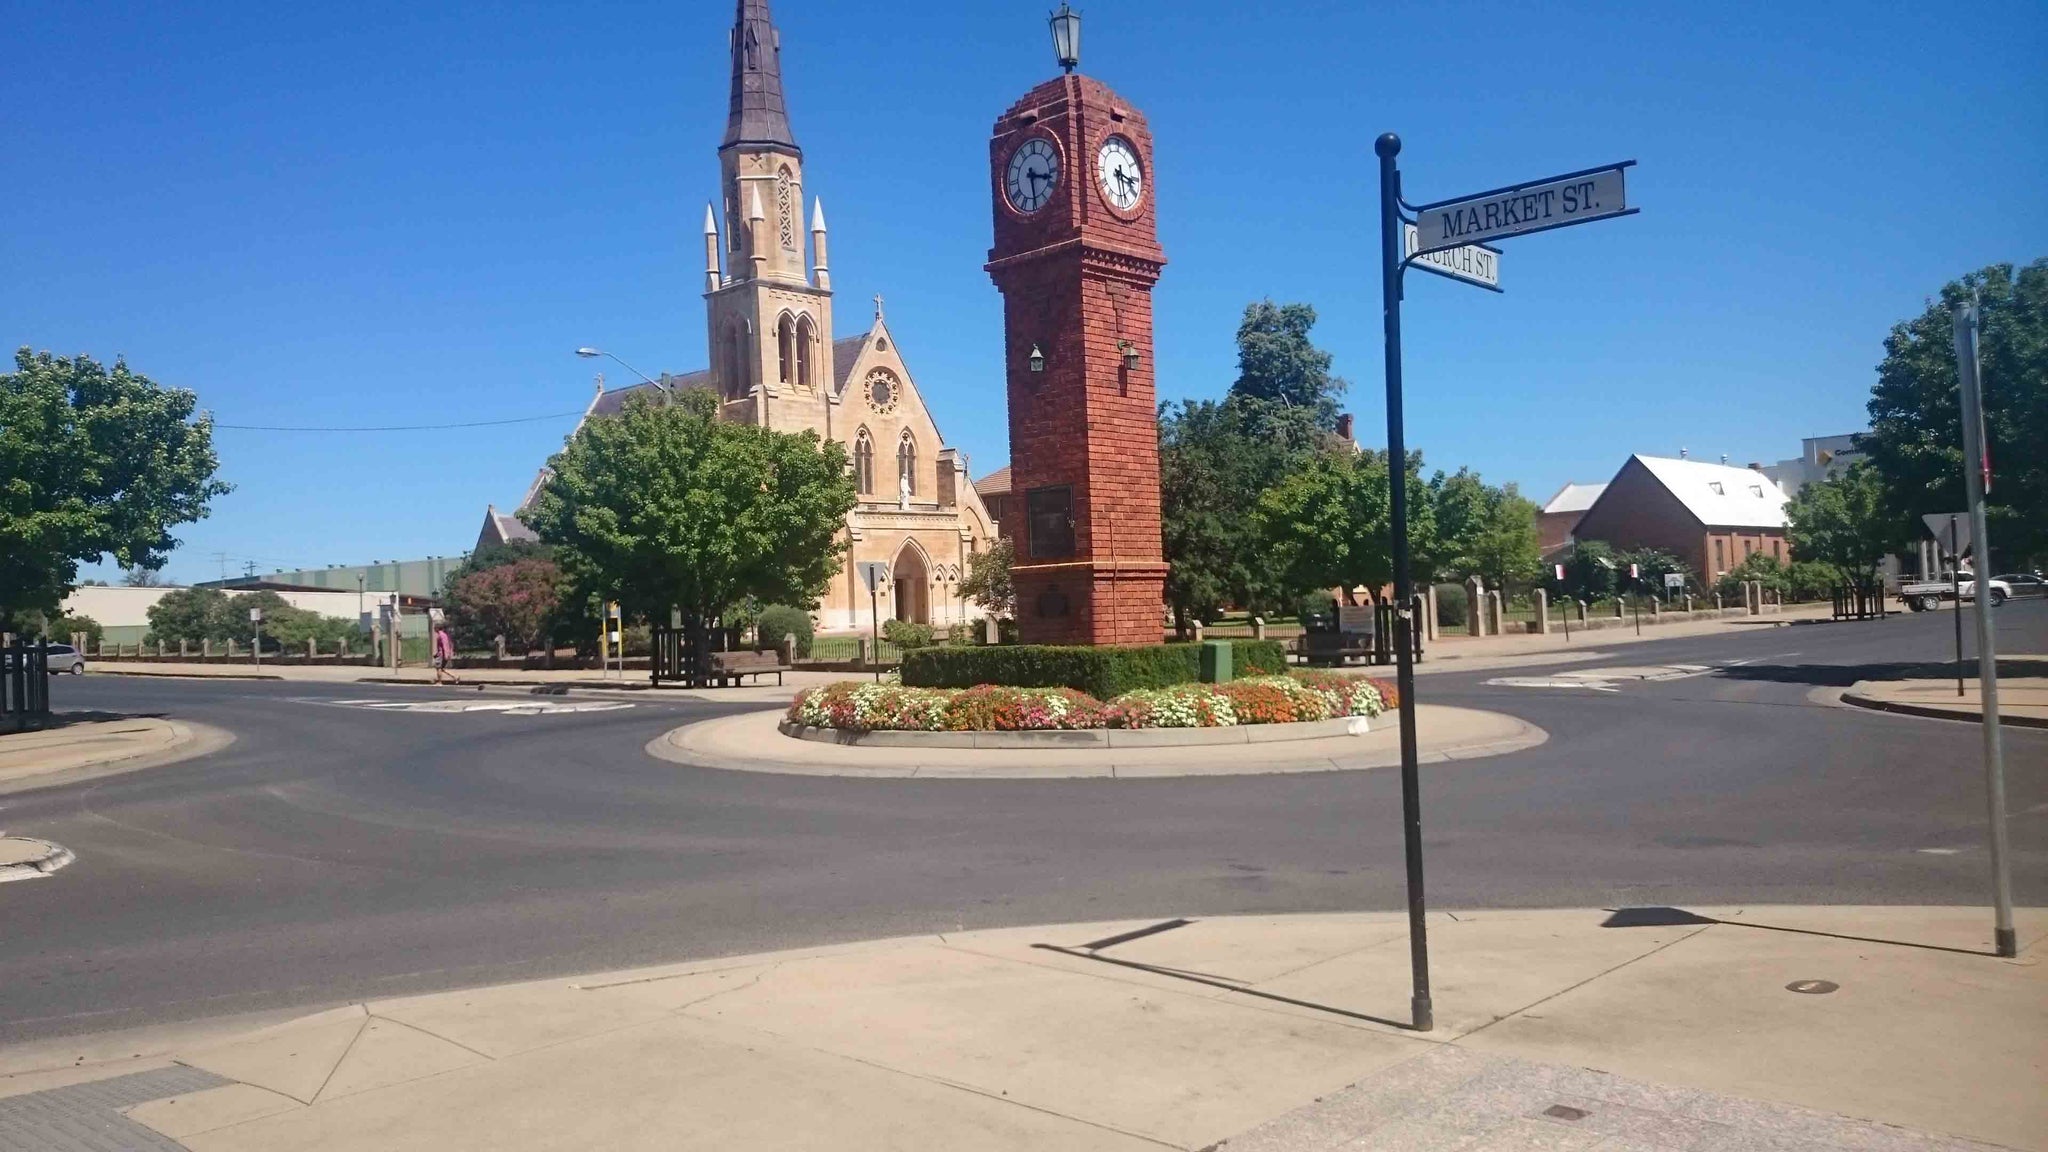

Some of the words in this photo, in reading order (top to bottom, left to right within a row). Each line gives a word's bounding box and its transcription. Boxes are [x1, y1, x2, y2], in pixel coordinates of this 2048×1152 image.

[1442, 190, 1555, 239] MARKET
[1562, 181, 1600, 214] ST.
[1475, 251, 1495, 280] ST.
